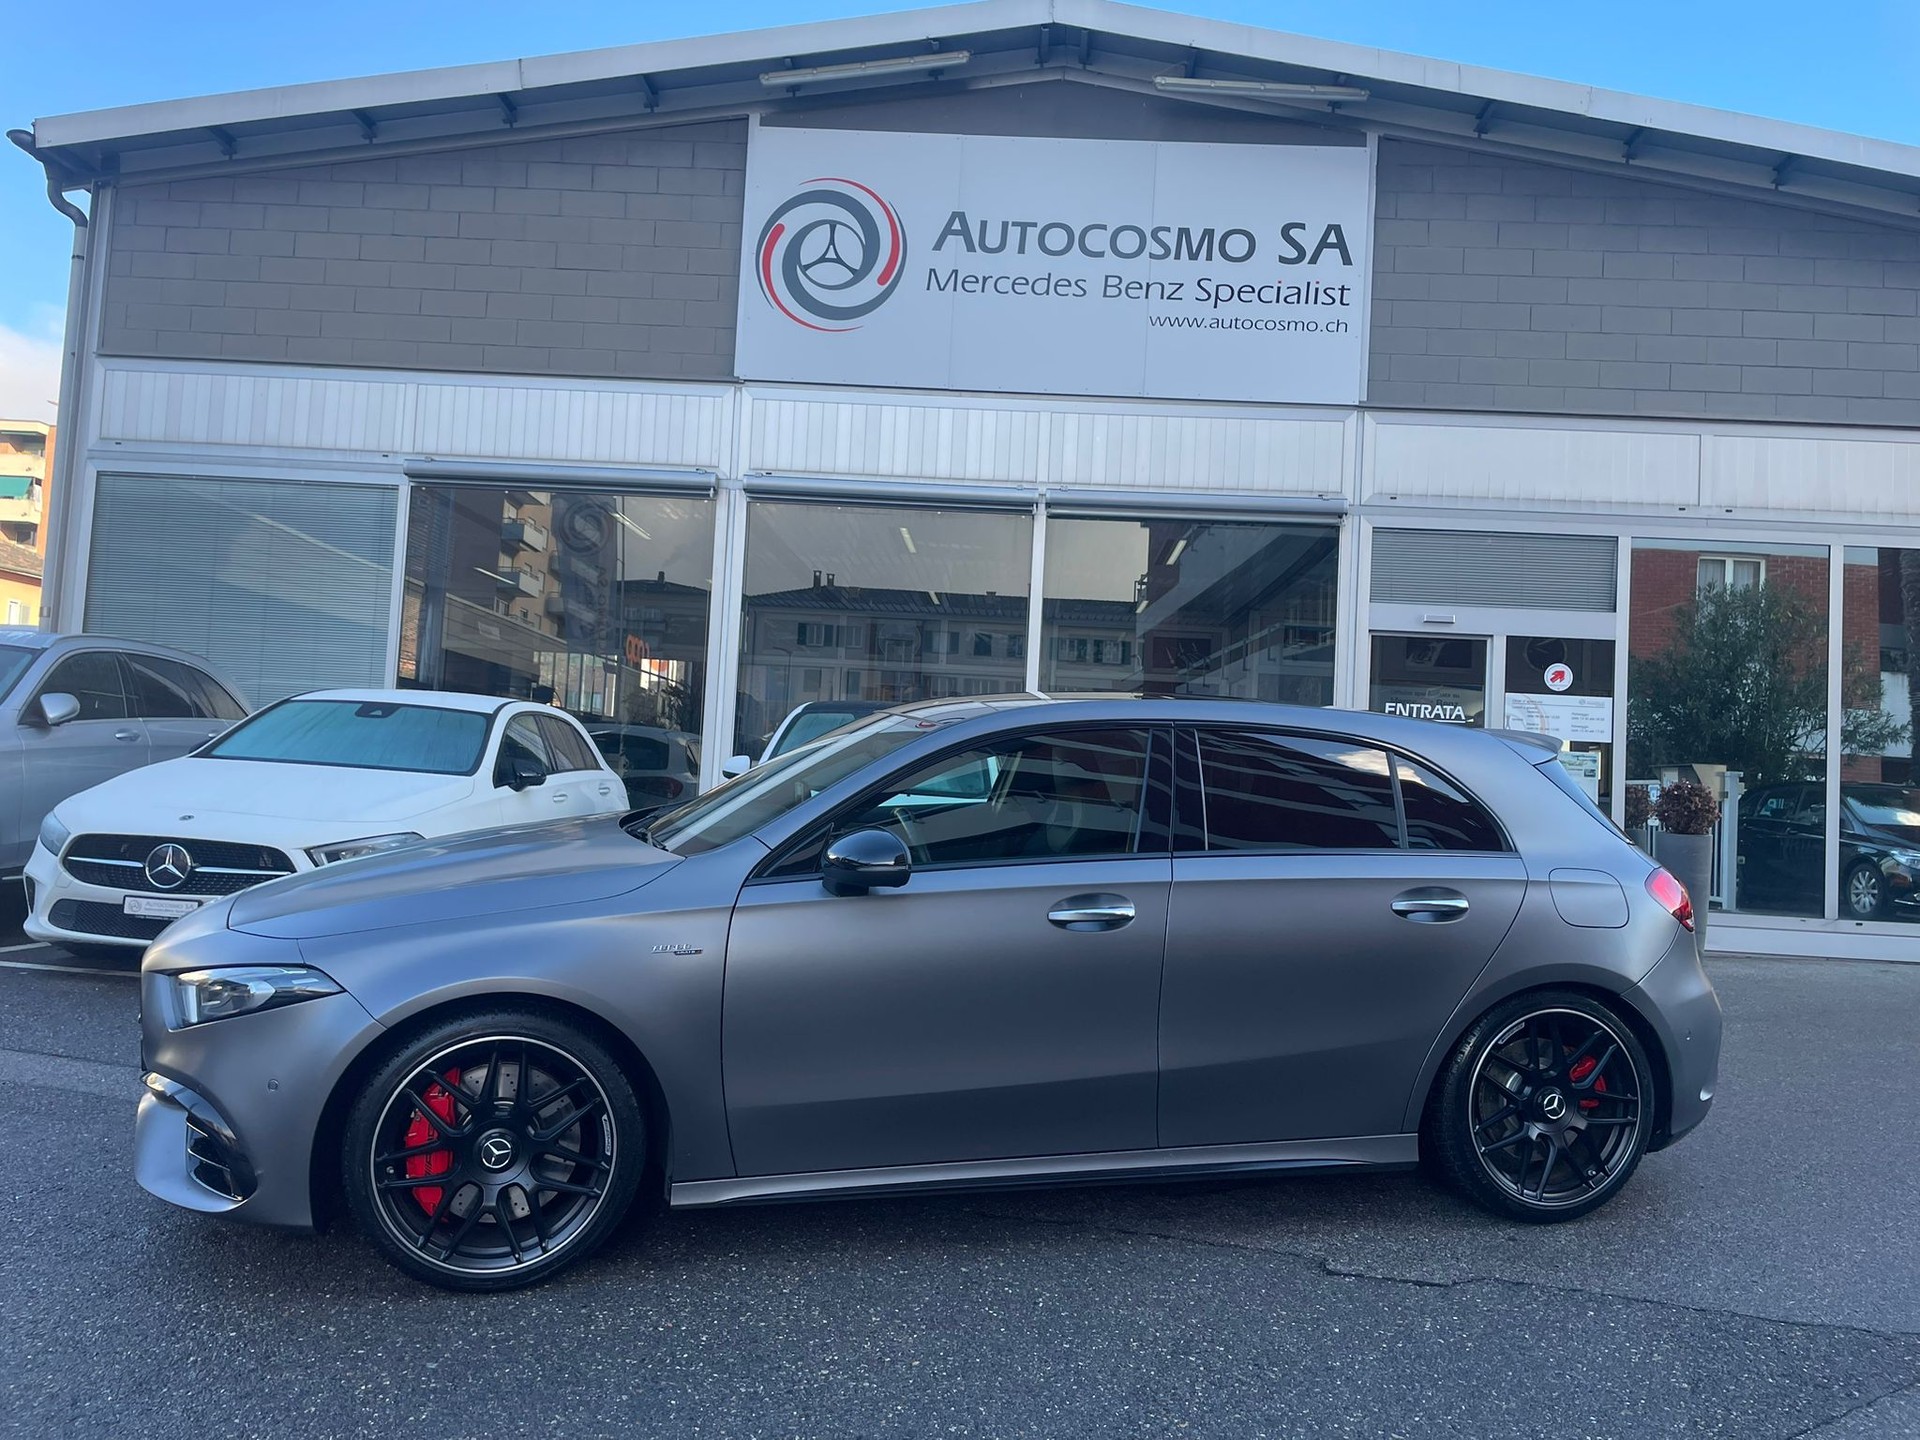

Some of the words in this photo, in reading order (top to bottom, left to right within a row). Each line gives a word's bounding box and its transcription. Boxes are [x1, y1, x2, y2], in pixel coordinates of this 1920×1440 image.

[931, 210, 1257, 263] AUTOCOSMO
[1278, 221, 1354, 267] SA
[926, 267, 1087, 299] Mercedes
[1102, 274, 1185, 301] Benz
[1194, 277, 1352, 312] Specialist
[1149, 315, 1348, 333] www.autocosmo.ch
[1385, 702, 1466, 720] ENTRATA
